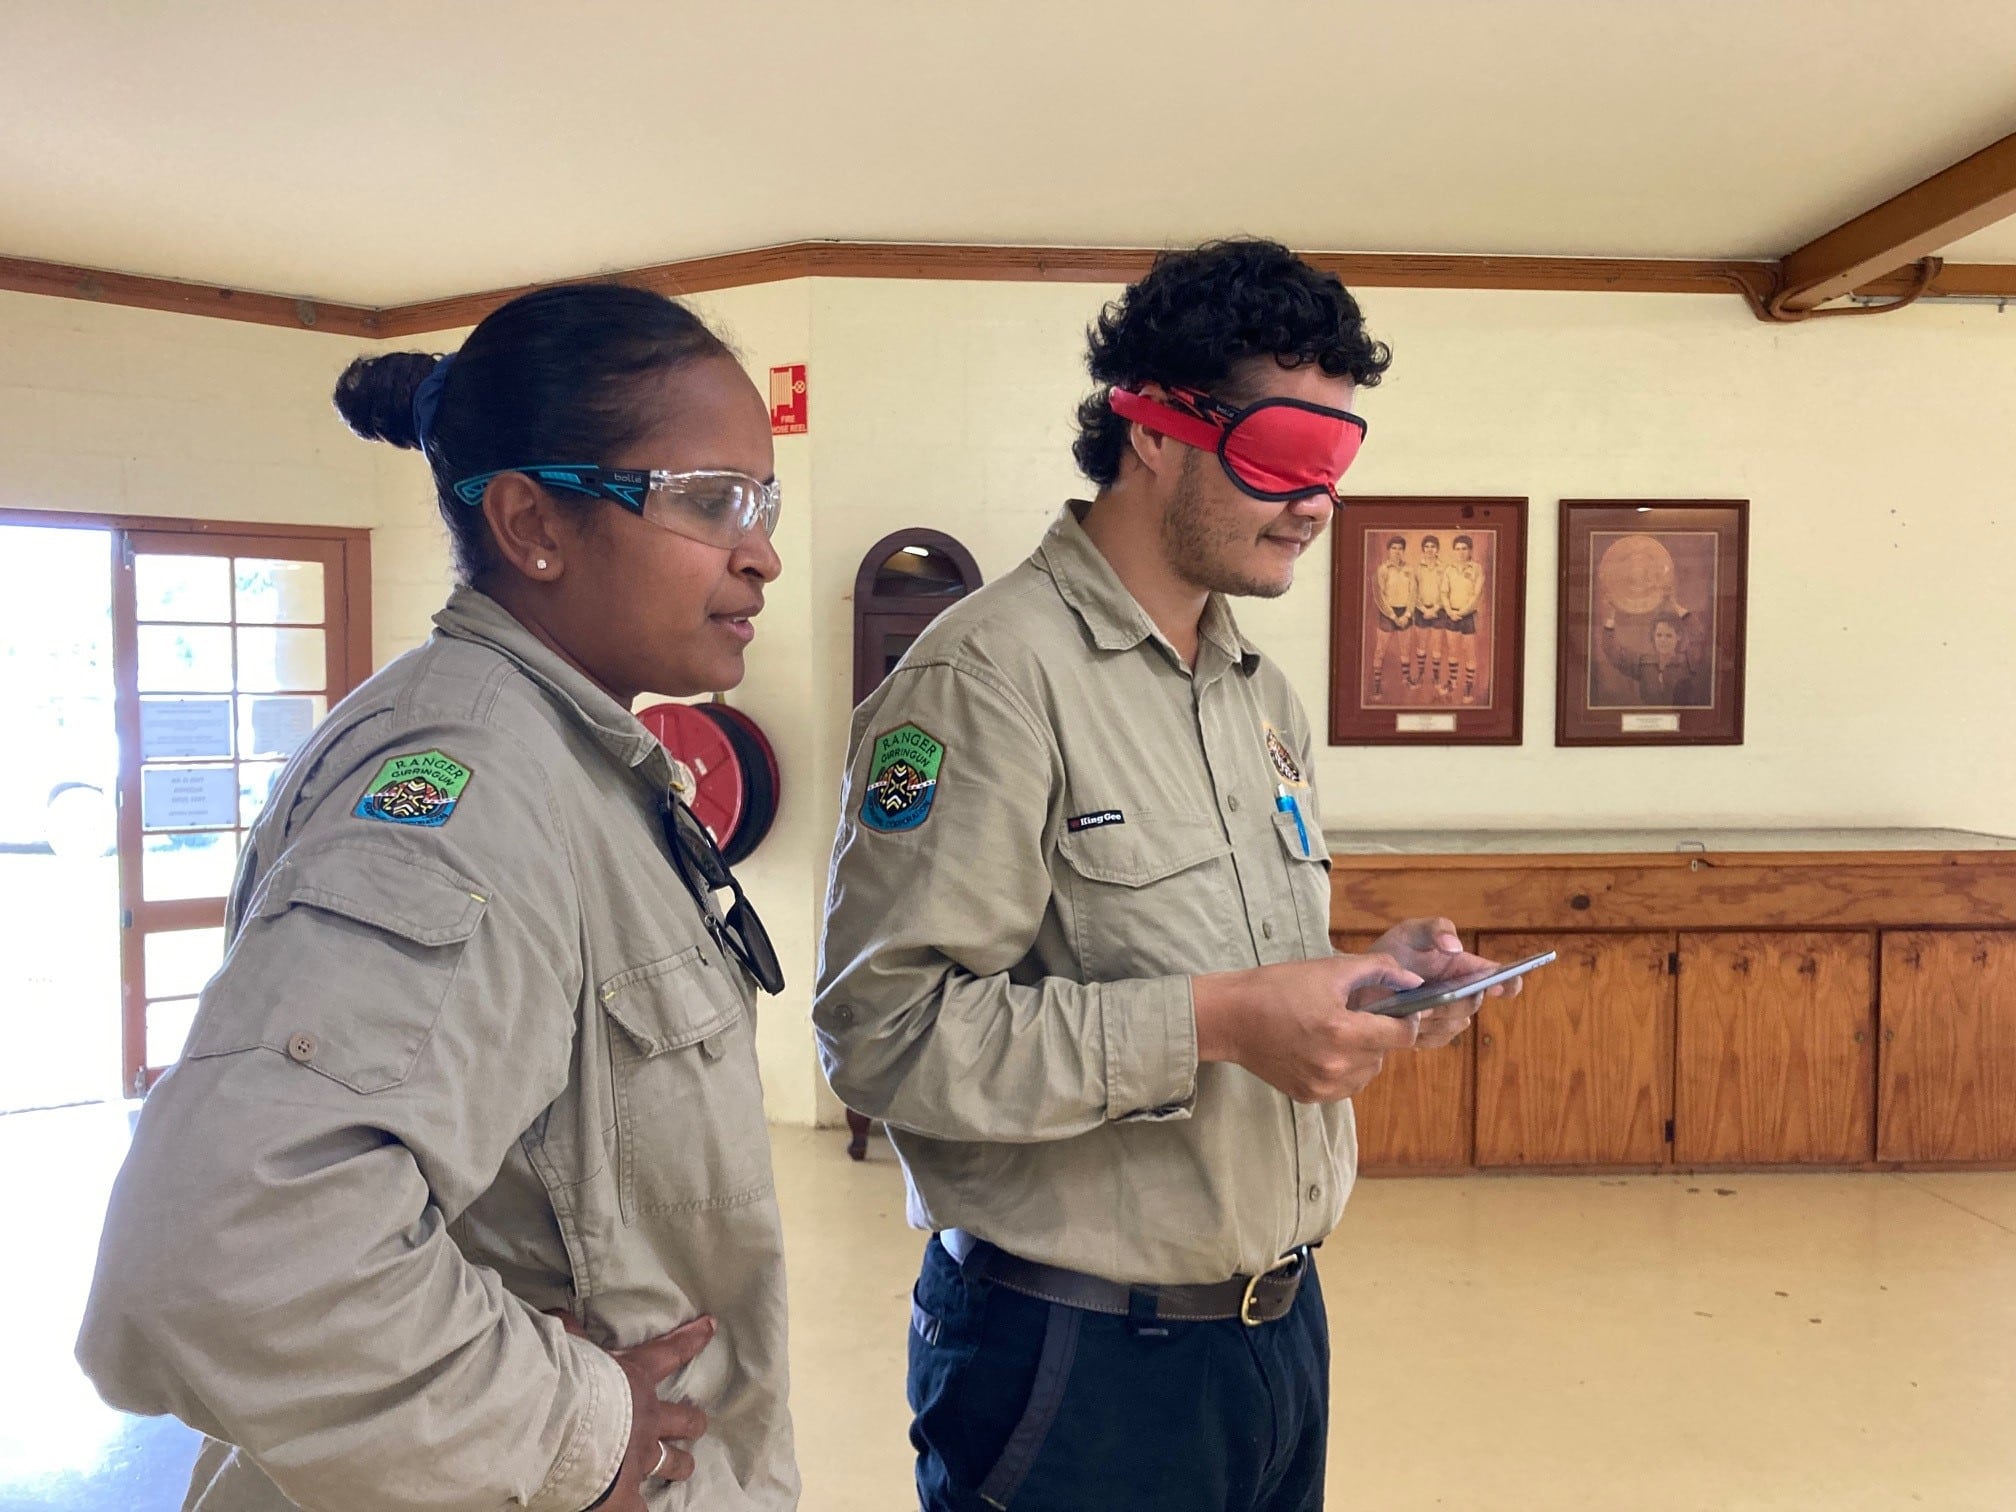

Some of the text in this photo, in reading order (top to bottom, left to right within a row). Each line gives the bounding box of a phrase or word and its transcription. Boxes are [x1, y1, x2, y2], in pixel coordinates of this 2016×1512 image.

[780, 414, 796, 424] FIRE
[790, 423, 806, 433] REEL
[882, 732, 937, 758] RANGER
[881, 748, 930, 767] GIRRINGUN
[391, 767, 455, 786] GIRRINGUN
[396, 757, 464, 779] RANGER
